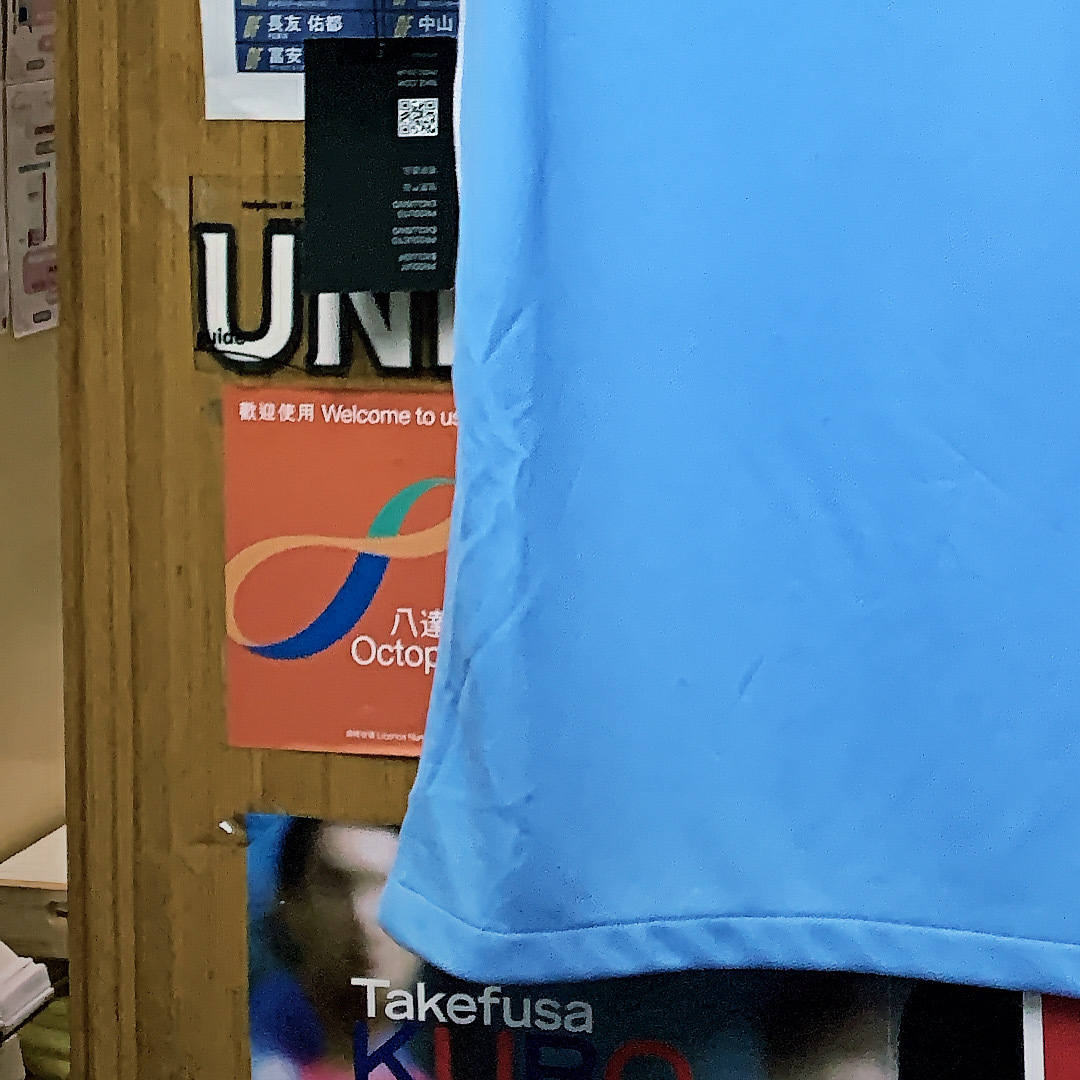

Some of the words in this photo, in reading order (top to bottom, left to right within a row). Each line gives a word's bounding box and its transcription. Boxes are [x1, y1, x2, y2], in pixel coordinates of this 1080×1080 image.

[418, 14, 453, 32] 中山
[200, 232, 454, 368] UN
[321, 403, 412, 426] Welcome
[414, 406, 437, 426] to
[351, 977, 593, 1034] Takefusa
